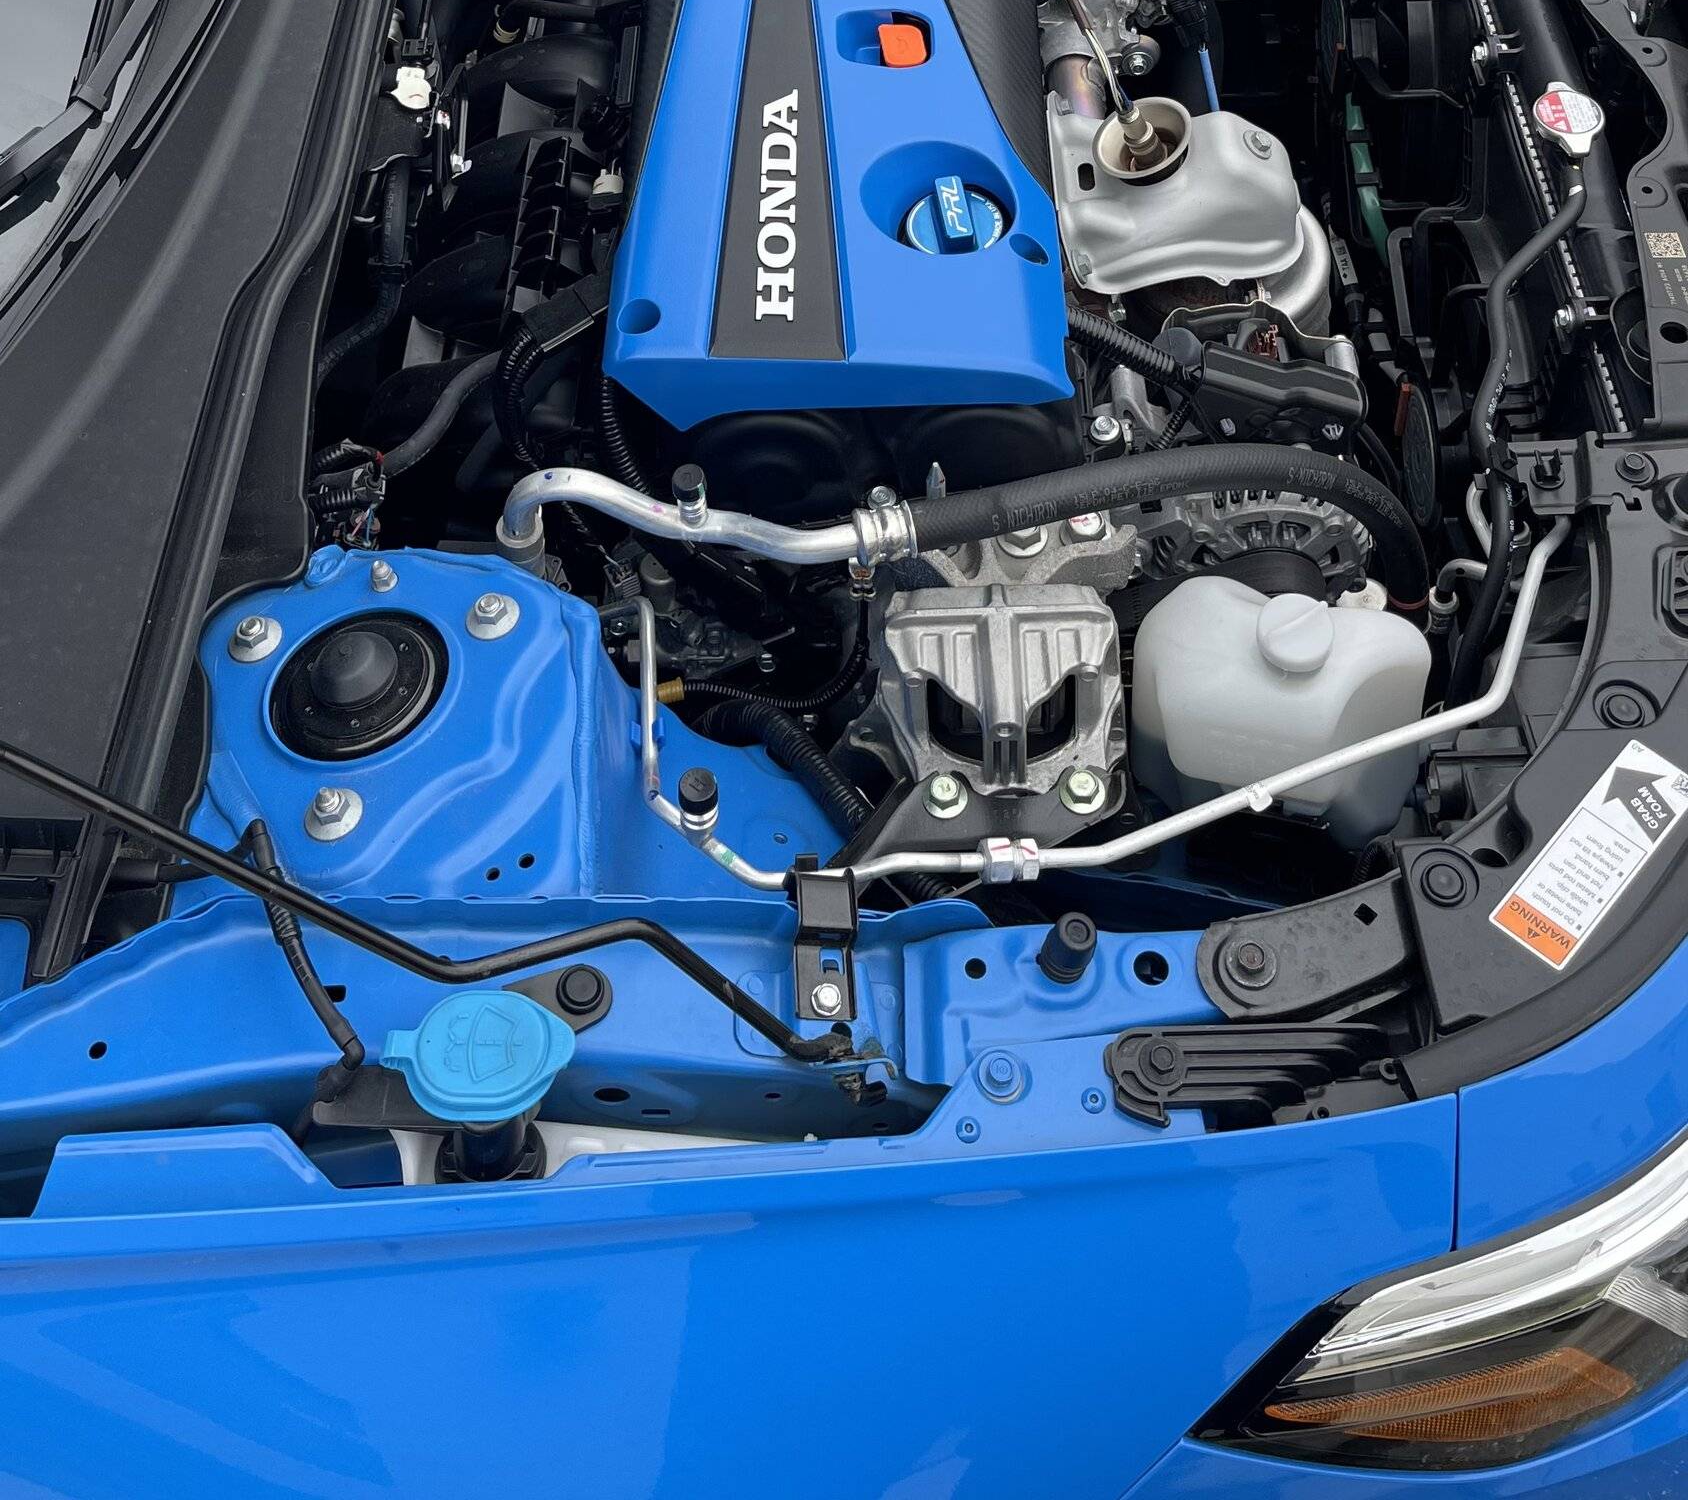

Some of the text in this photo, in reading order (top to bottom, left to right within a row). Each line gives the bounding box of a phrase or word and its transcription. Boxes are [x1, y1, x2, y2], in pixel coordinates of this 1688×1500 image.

[755, 88, 799, 321] HONDA
[940, 177, 968, 232] PRL
[1630, 797, 1659, 829] GRAB
[1637, 786, 1668, 819] FOAM
[1569, 836, 1583, 848] rod
[1585, 833, 1624, 864] using foam
[1562, 858, 1603, 890] hot and can
[1590, 850, 1618, 873] Always
[1592, 865, 1610, 881] burn
[1544, 887, 1565, 904] metal
[1547, 860, 1596, 899] Metal rod gets
[1530, 890, 1575, 925] Do not touch
[1564, 901, 1582, 916] bare
[1508, 899, 1570, 949] WARNING
